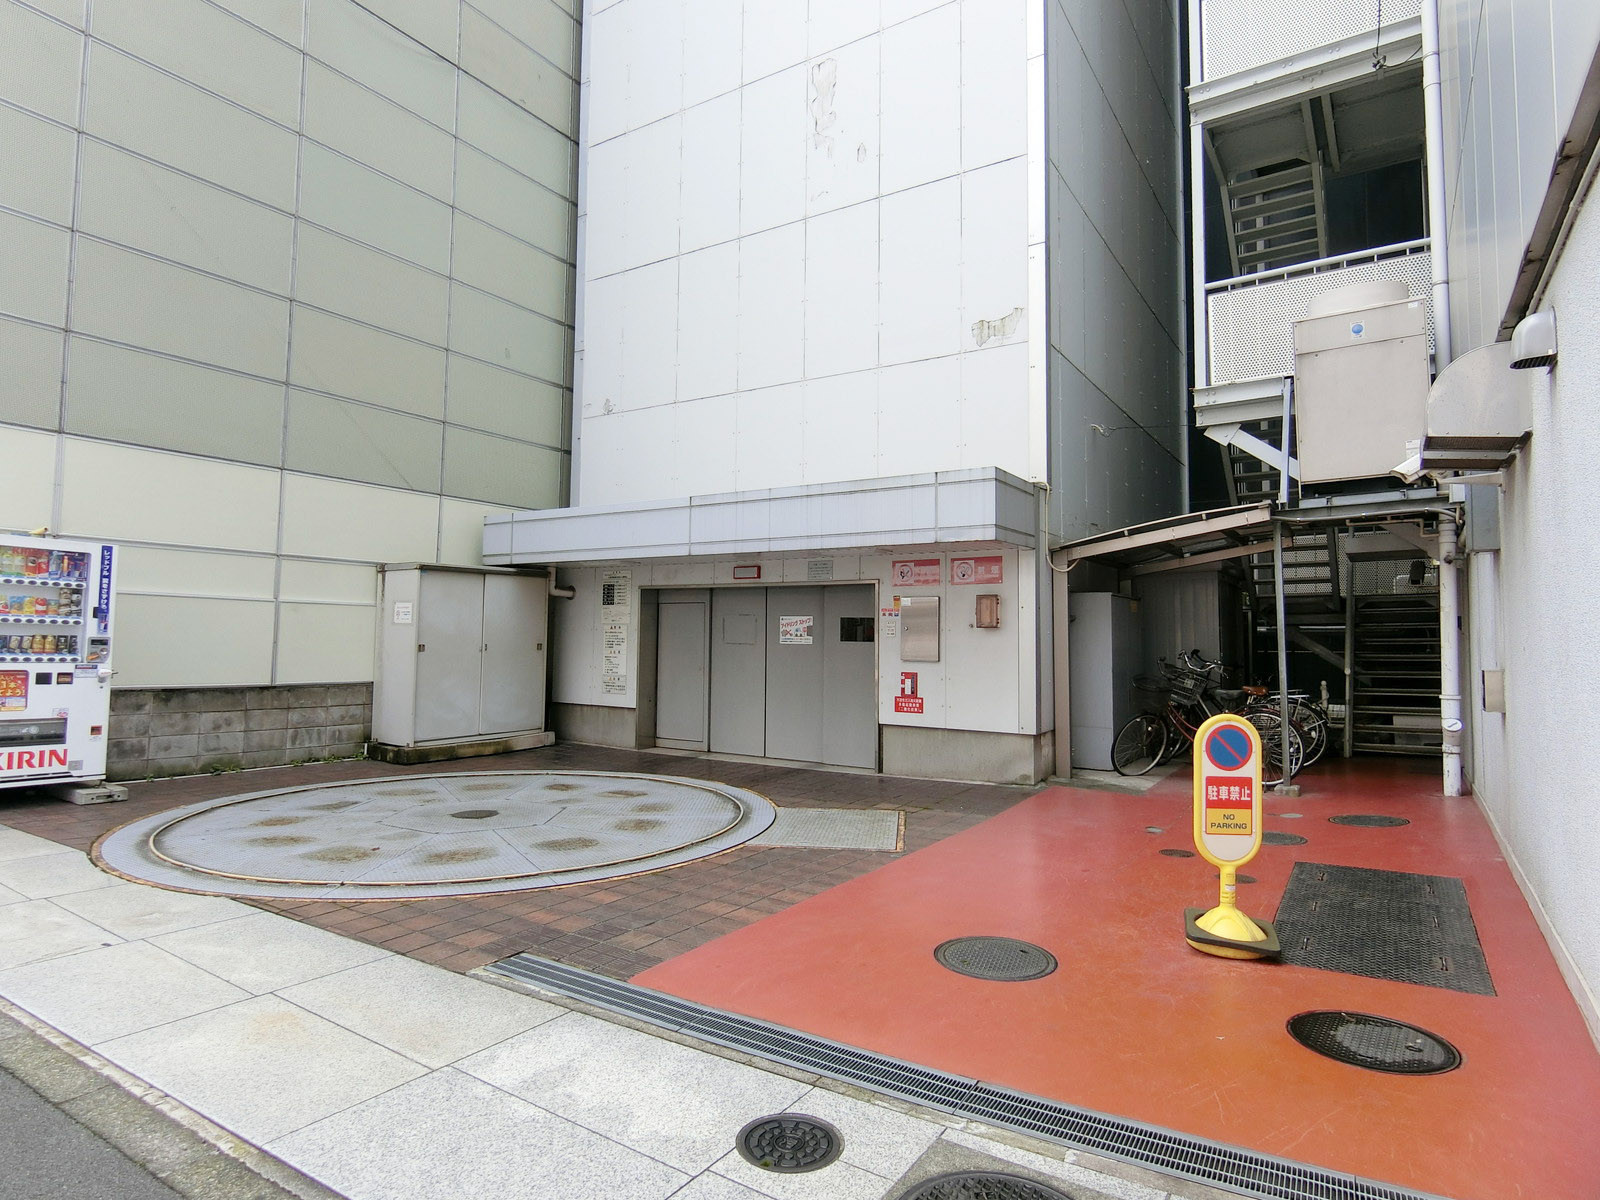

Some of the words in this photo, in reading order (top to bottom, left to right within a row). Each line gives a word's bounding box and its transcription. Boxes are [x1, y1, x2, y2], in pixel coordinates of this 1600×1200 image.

[1207, 785, 1251, 801] 駐車禁止
[1222, 813, 1235, 821] NO
[1210, 822, 1247, 830] PARKING
